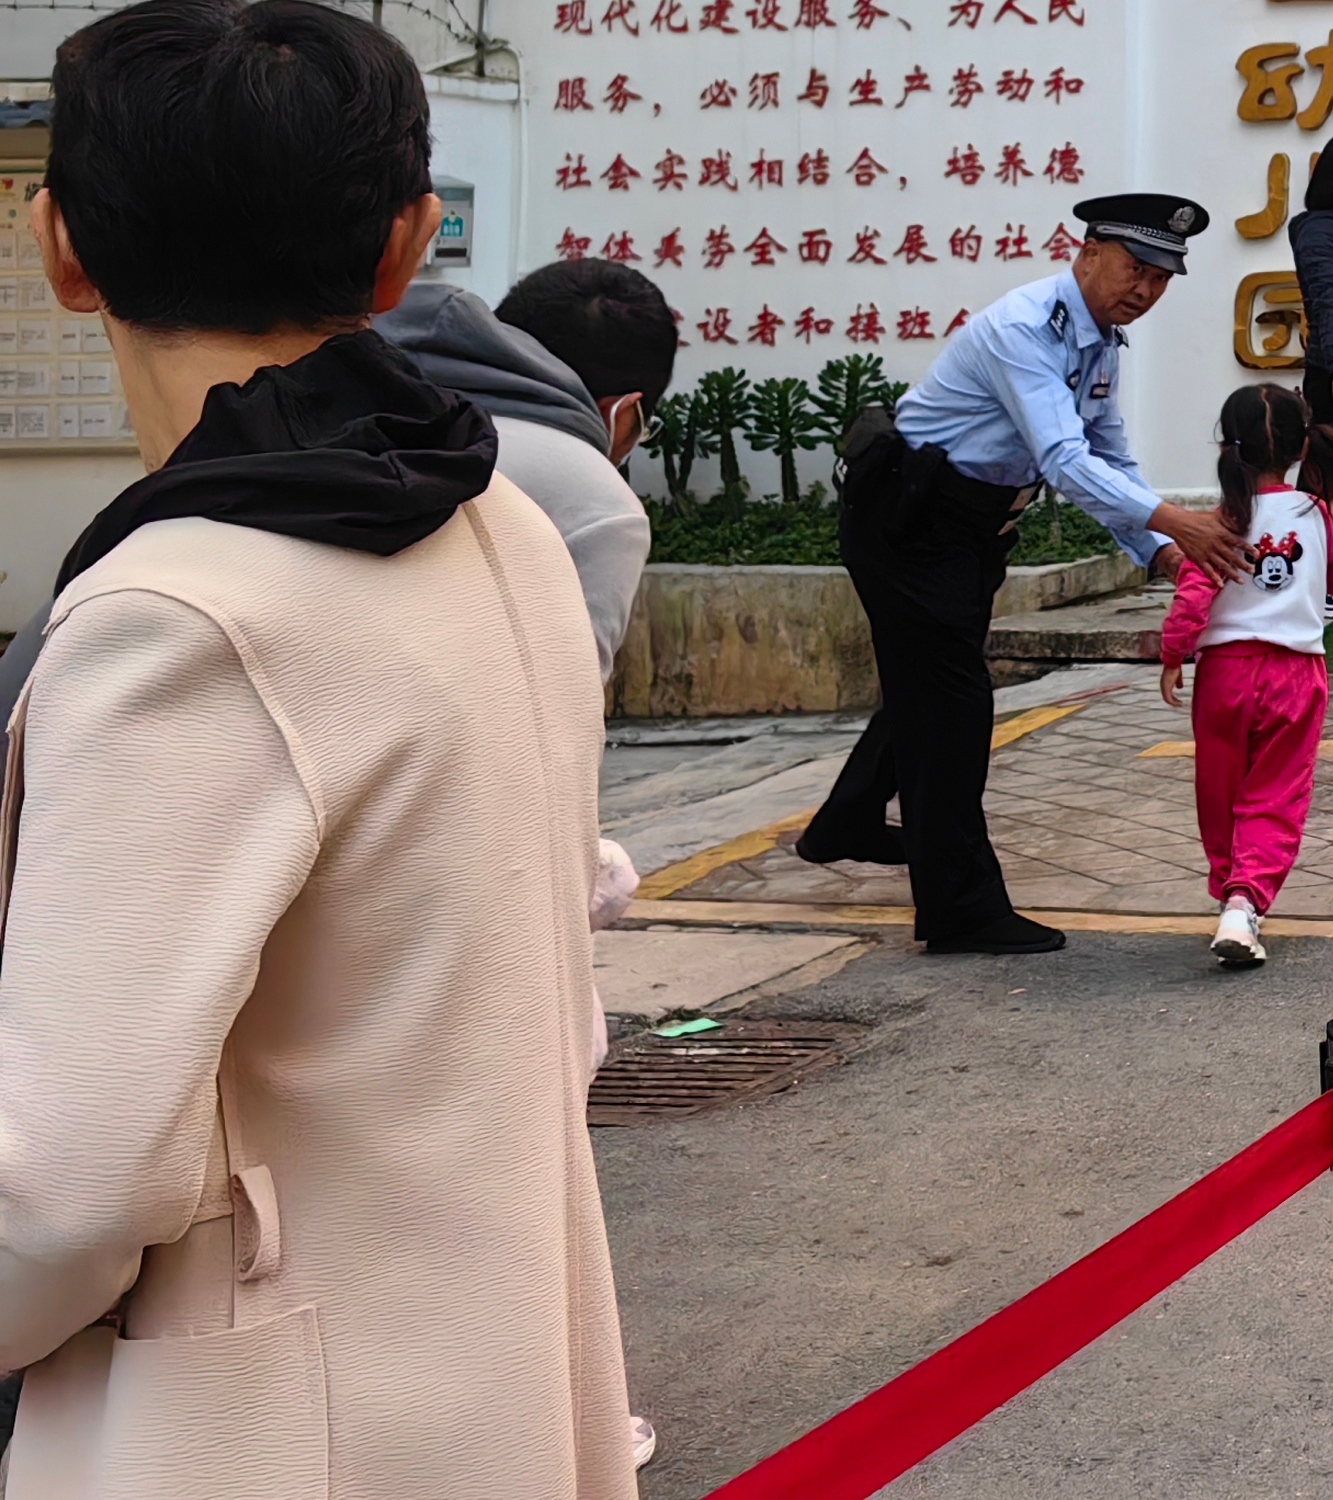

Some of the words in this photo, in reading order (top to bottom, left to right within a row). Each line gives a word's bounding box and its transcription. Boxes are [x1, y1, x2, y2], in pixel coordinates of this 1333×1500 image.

[554, 64, 1085, 117] 服务，必须与生产劳动和
[555, 141, 1085, 191] 社会实践相结合，培养德
